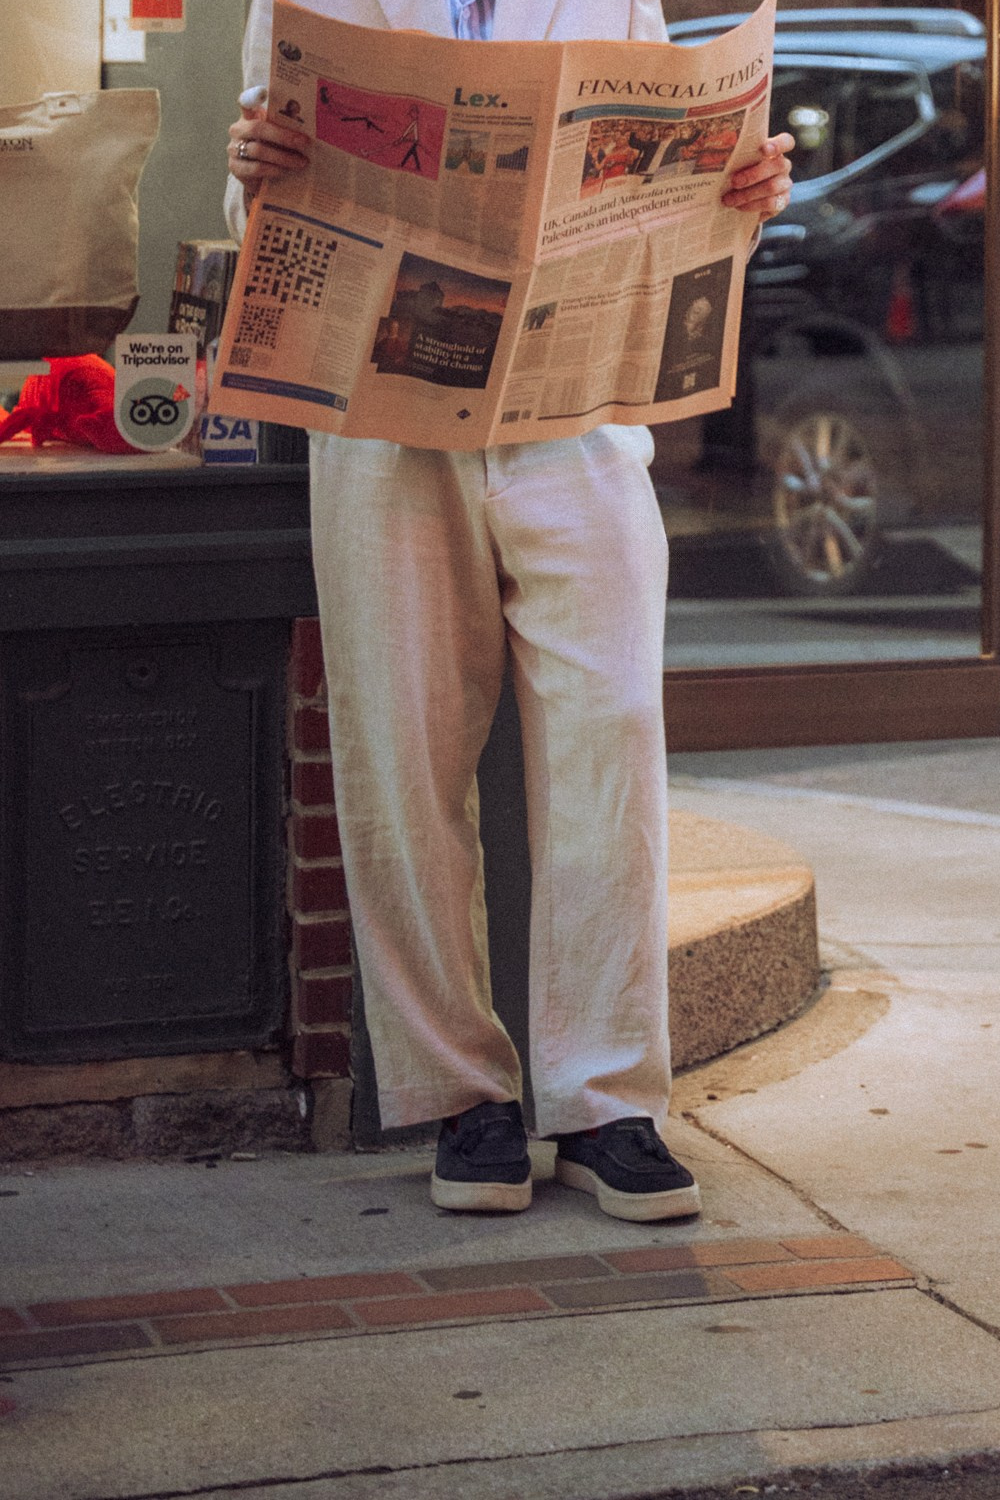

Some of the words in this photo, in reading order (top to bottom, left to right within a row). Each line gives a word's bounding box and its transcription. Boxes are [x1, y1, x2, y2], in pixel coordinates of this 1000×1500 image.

[577, 78, 709, 99] FINANCIAL
[716, 52, 765, 93] TIMES
[453, 87, 508, 109] Lex.
[562, 206, 598, 224] Canada
[596, 197, 617, 213] and
[618, 187, 664, 206] Australia
[663, 180, 716, 196] recognise
[541, 225, 583, 246] Palestine
[584, 221, 596, 232] as
[596, 216, 609, 227] an
[609, 198, 670, 224] independent
[671, 192, 697, 206] state
[129, 342, 165, 354] We're
[167, 344, 183, 354] on
[415, 342, 450, 359] stability
[417, 333, 424, 341] A
[425, 337, 475, 354] stronghold
[476, 346, 487, 354] of
[122, 354, 191, 368] Tripadvisor
[413, 351, 439, 364] world
[200, 414, 253, 440] ISA
[60, 780, 222, 828] ELECTRIC
[75, 840, 207, 873] SERVICE
